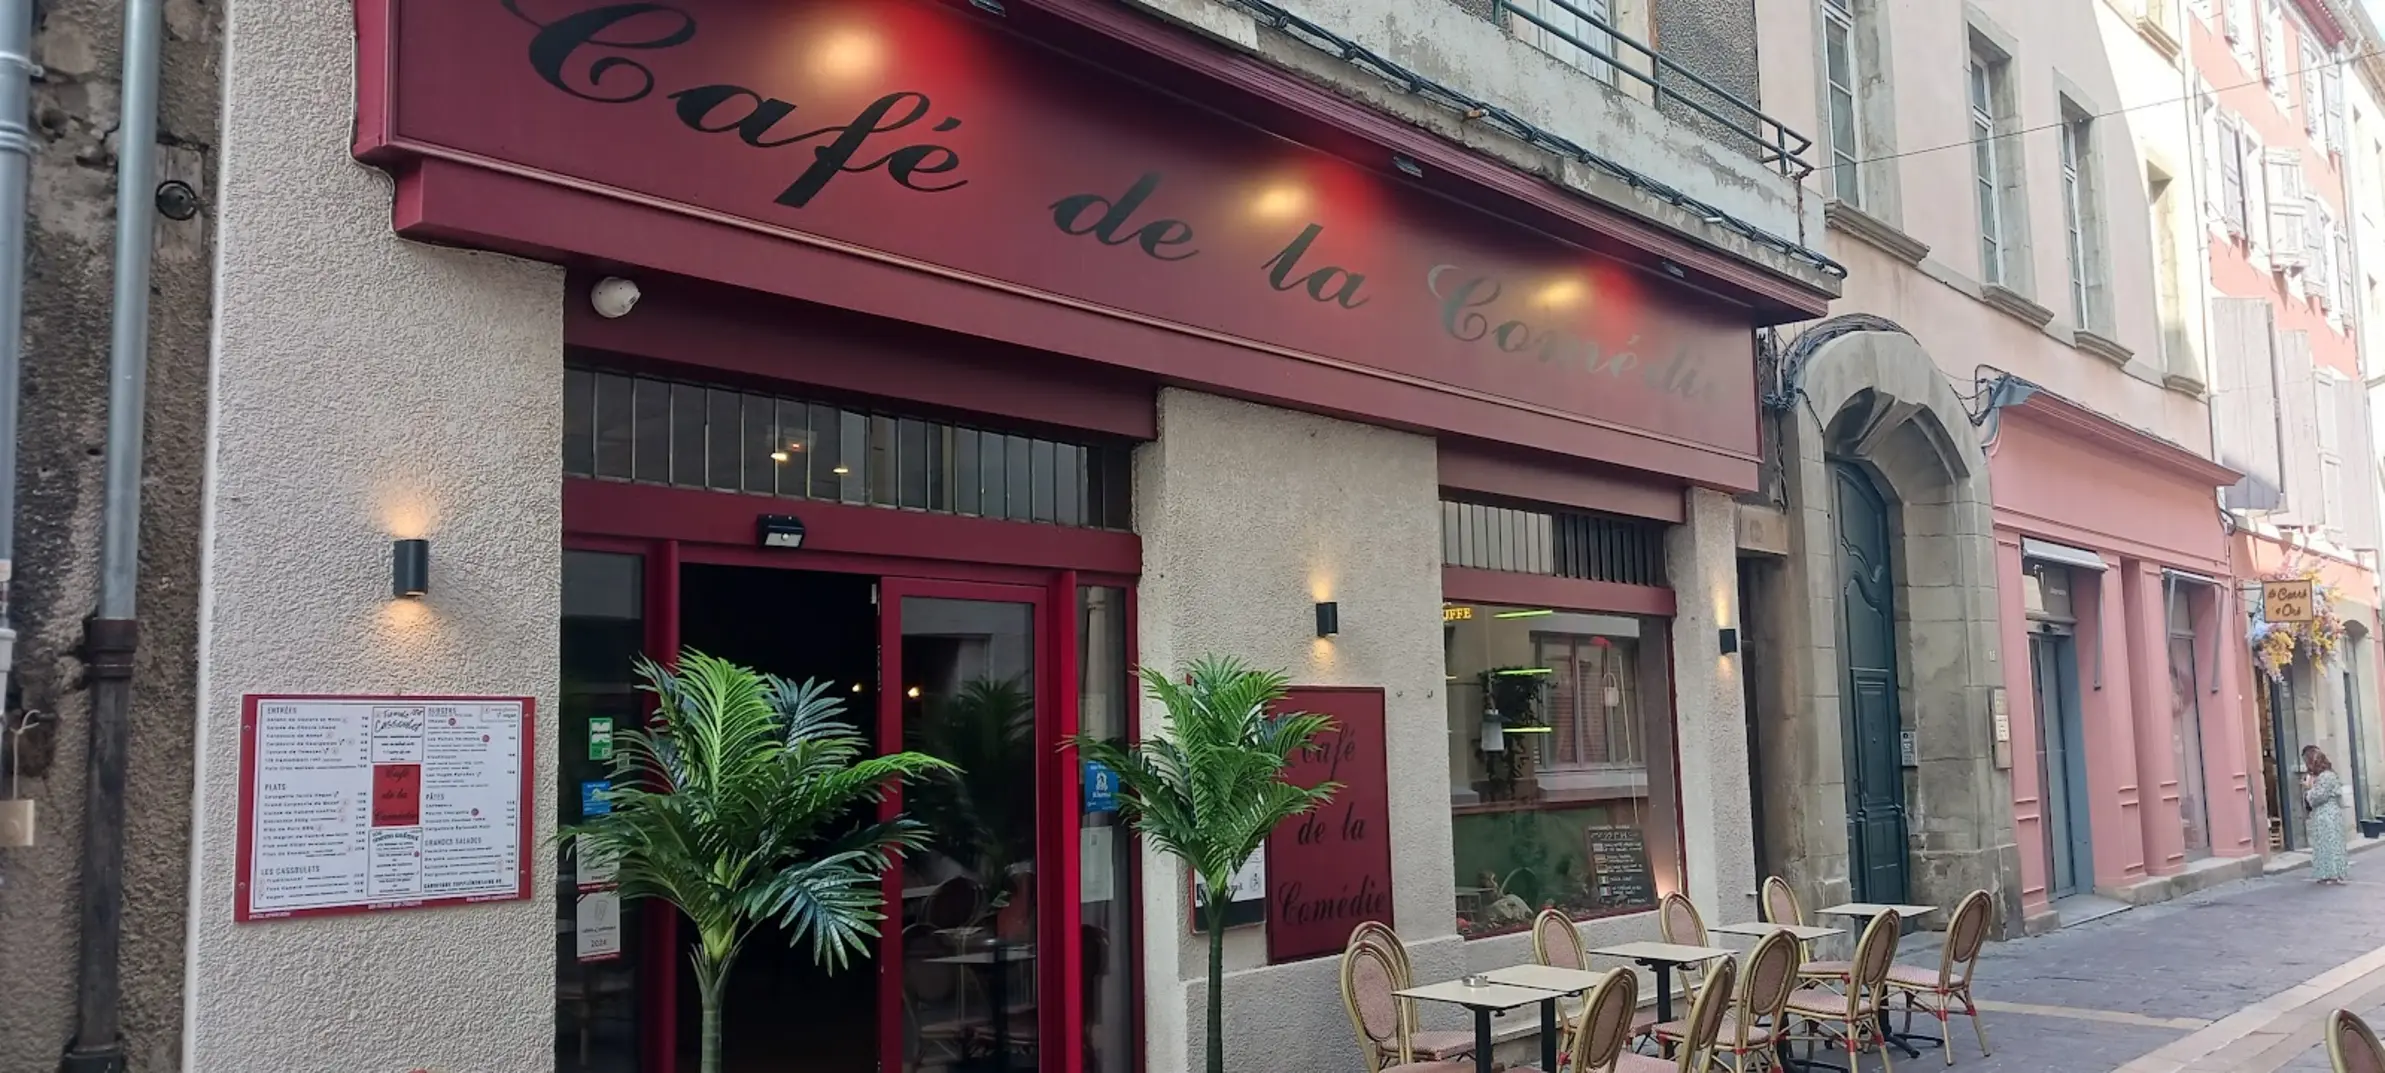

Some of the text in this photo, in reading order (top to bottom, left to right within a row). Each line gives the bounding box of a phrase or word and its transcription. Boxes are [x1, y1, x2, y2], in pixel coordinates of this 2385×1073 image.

[500, 0, 1727, 406] Café de la Comédie
[1301, 722, 1355, 781] Café
[1298, 803, 1367, 845] de la
[1279, 875, 1386, 925] Comédie
